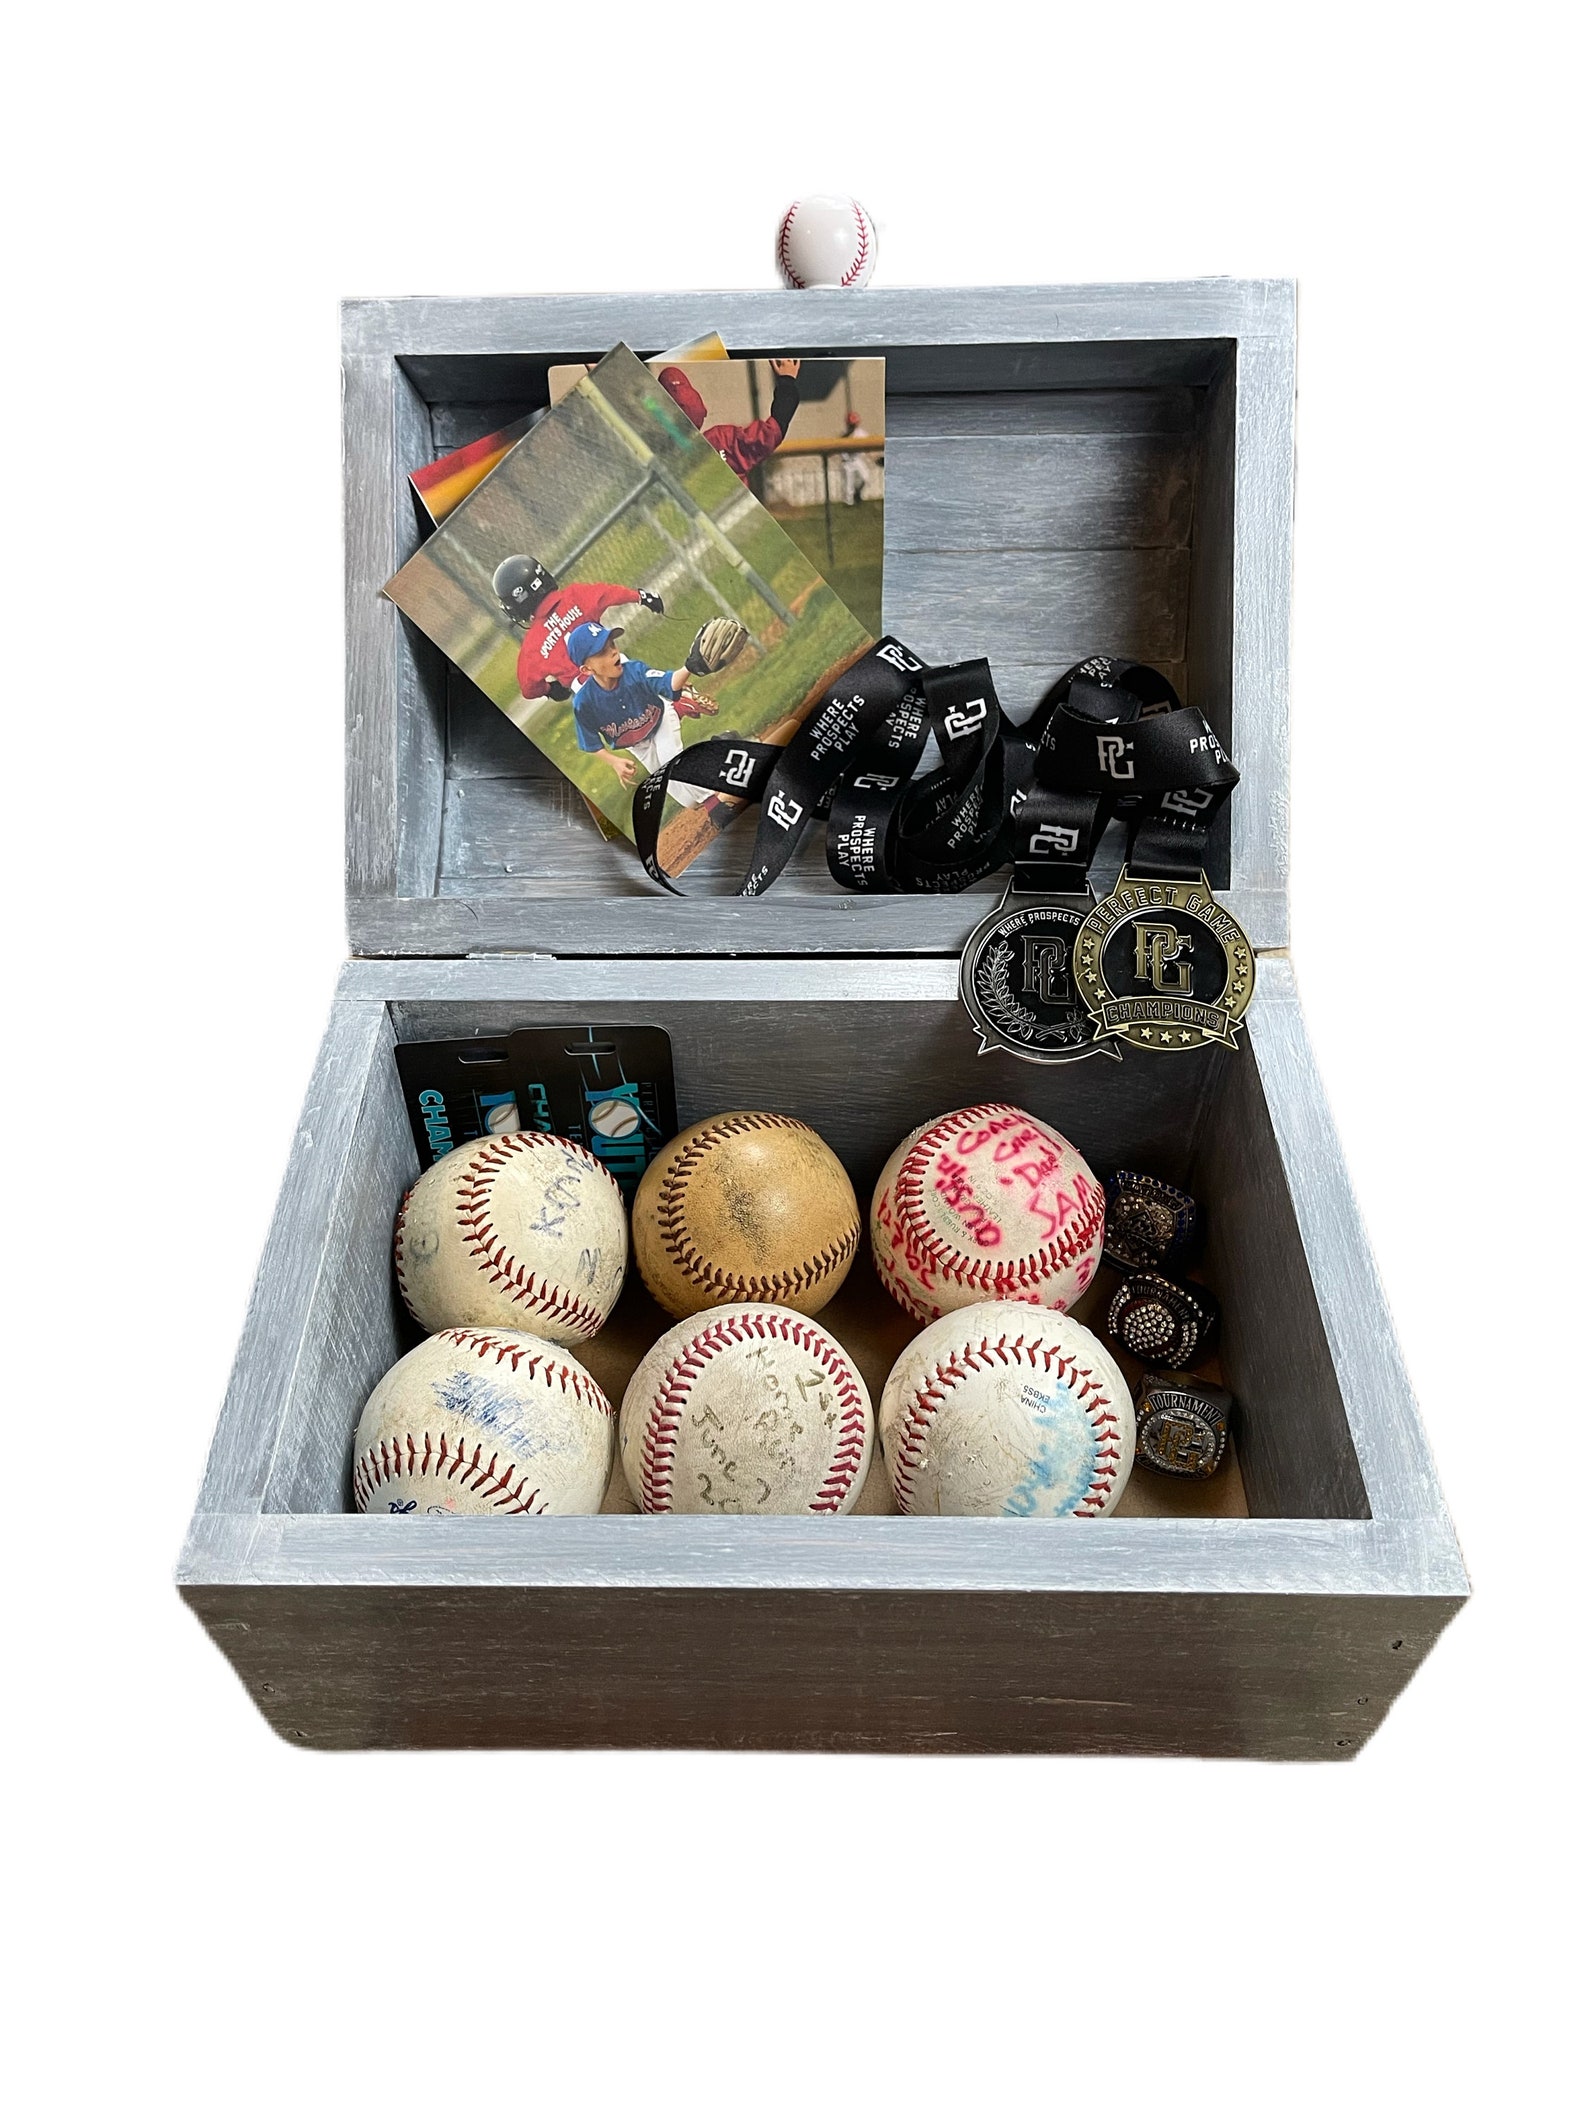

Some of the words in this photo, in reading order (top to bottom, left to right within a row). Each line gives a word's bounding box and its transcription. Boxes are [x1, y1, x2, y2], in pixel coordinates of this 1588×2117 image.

[539, 624, 563, 659] SPORTS
[559, 604, 584, 632] HOUSE
[544, 611, 563, 632] THE
[808, 698, 845, 740] WHERE
[810, 694, 866, 761] PROSPECTS
[904, 697, 927, 739] WHERE
[834, 722, 860, 753] PLAY
[837, 834, 850, 867] PLAY
[849, 815, 869, 887] PROSPECTS
[861, 827, 877, 873] WHERE
[997, 915, 1027, 938] WHERE
[1028, 912, 1081, 927] PROSPECTS
[1086, 887, 1178, 934] PERFECT
[1188, 894, 1242, 945] GAME
[1105, 1001, 1221, 1029] CHAMPIONS
[1020, 1393, 1048, 1414] CHINA
[1149, 1393, 1224, 1426] TOURNAMENT
